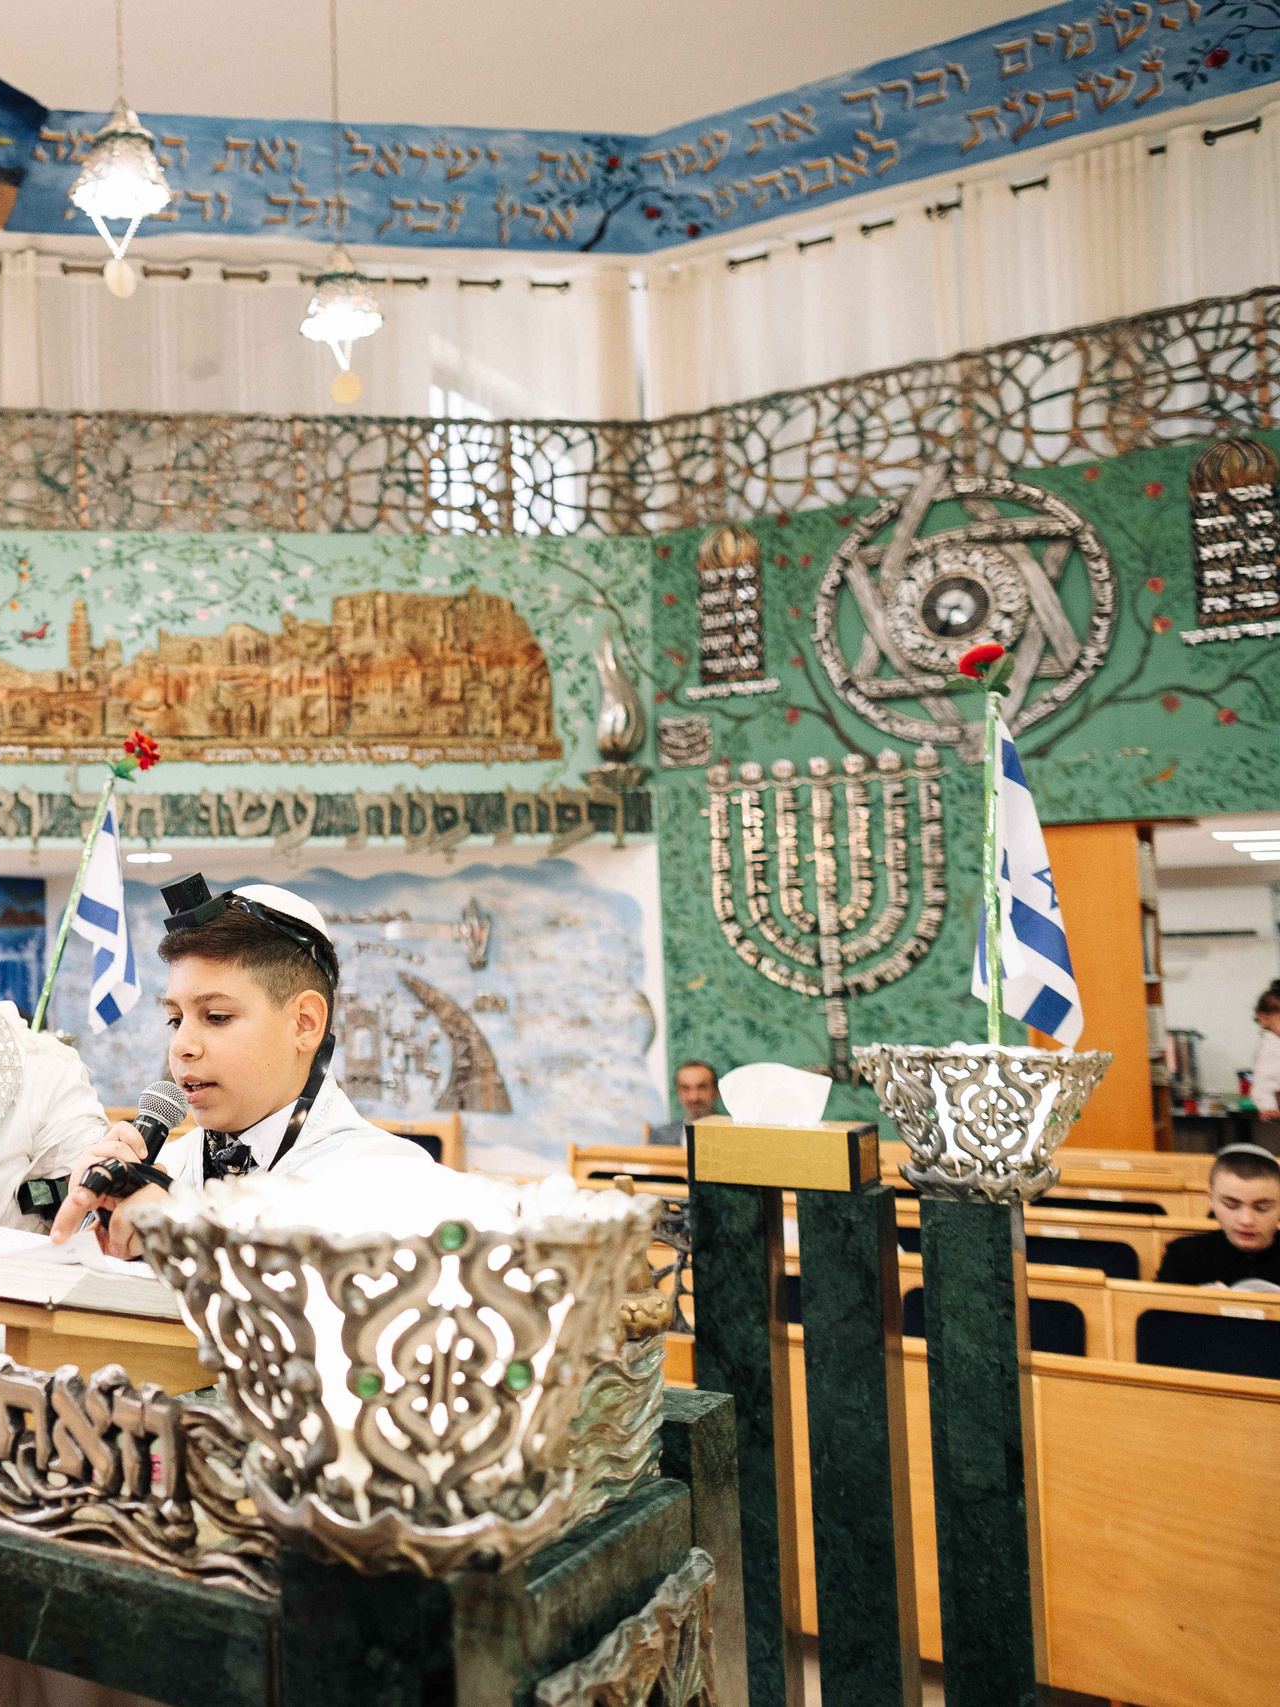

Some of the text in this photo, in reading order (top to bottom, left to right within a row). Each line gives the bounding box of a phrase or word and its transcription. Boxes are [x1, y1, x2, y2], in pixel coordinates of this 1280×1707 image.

[841, 62, 969, 132] וברך
[960, 46, 1165, 152] נשבעת
[213, 134, 301, 175] ואת
[344, 127, 501, 180] ישראל
[641, 125, 730, 187] עמך
[747, 103, 817, 157] את
[526, 150, 596, 184] את
[376, 190, 465, 234] זבת
[494, 183, 576, 243] ארץ
